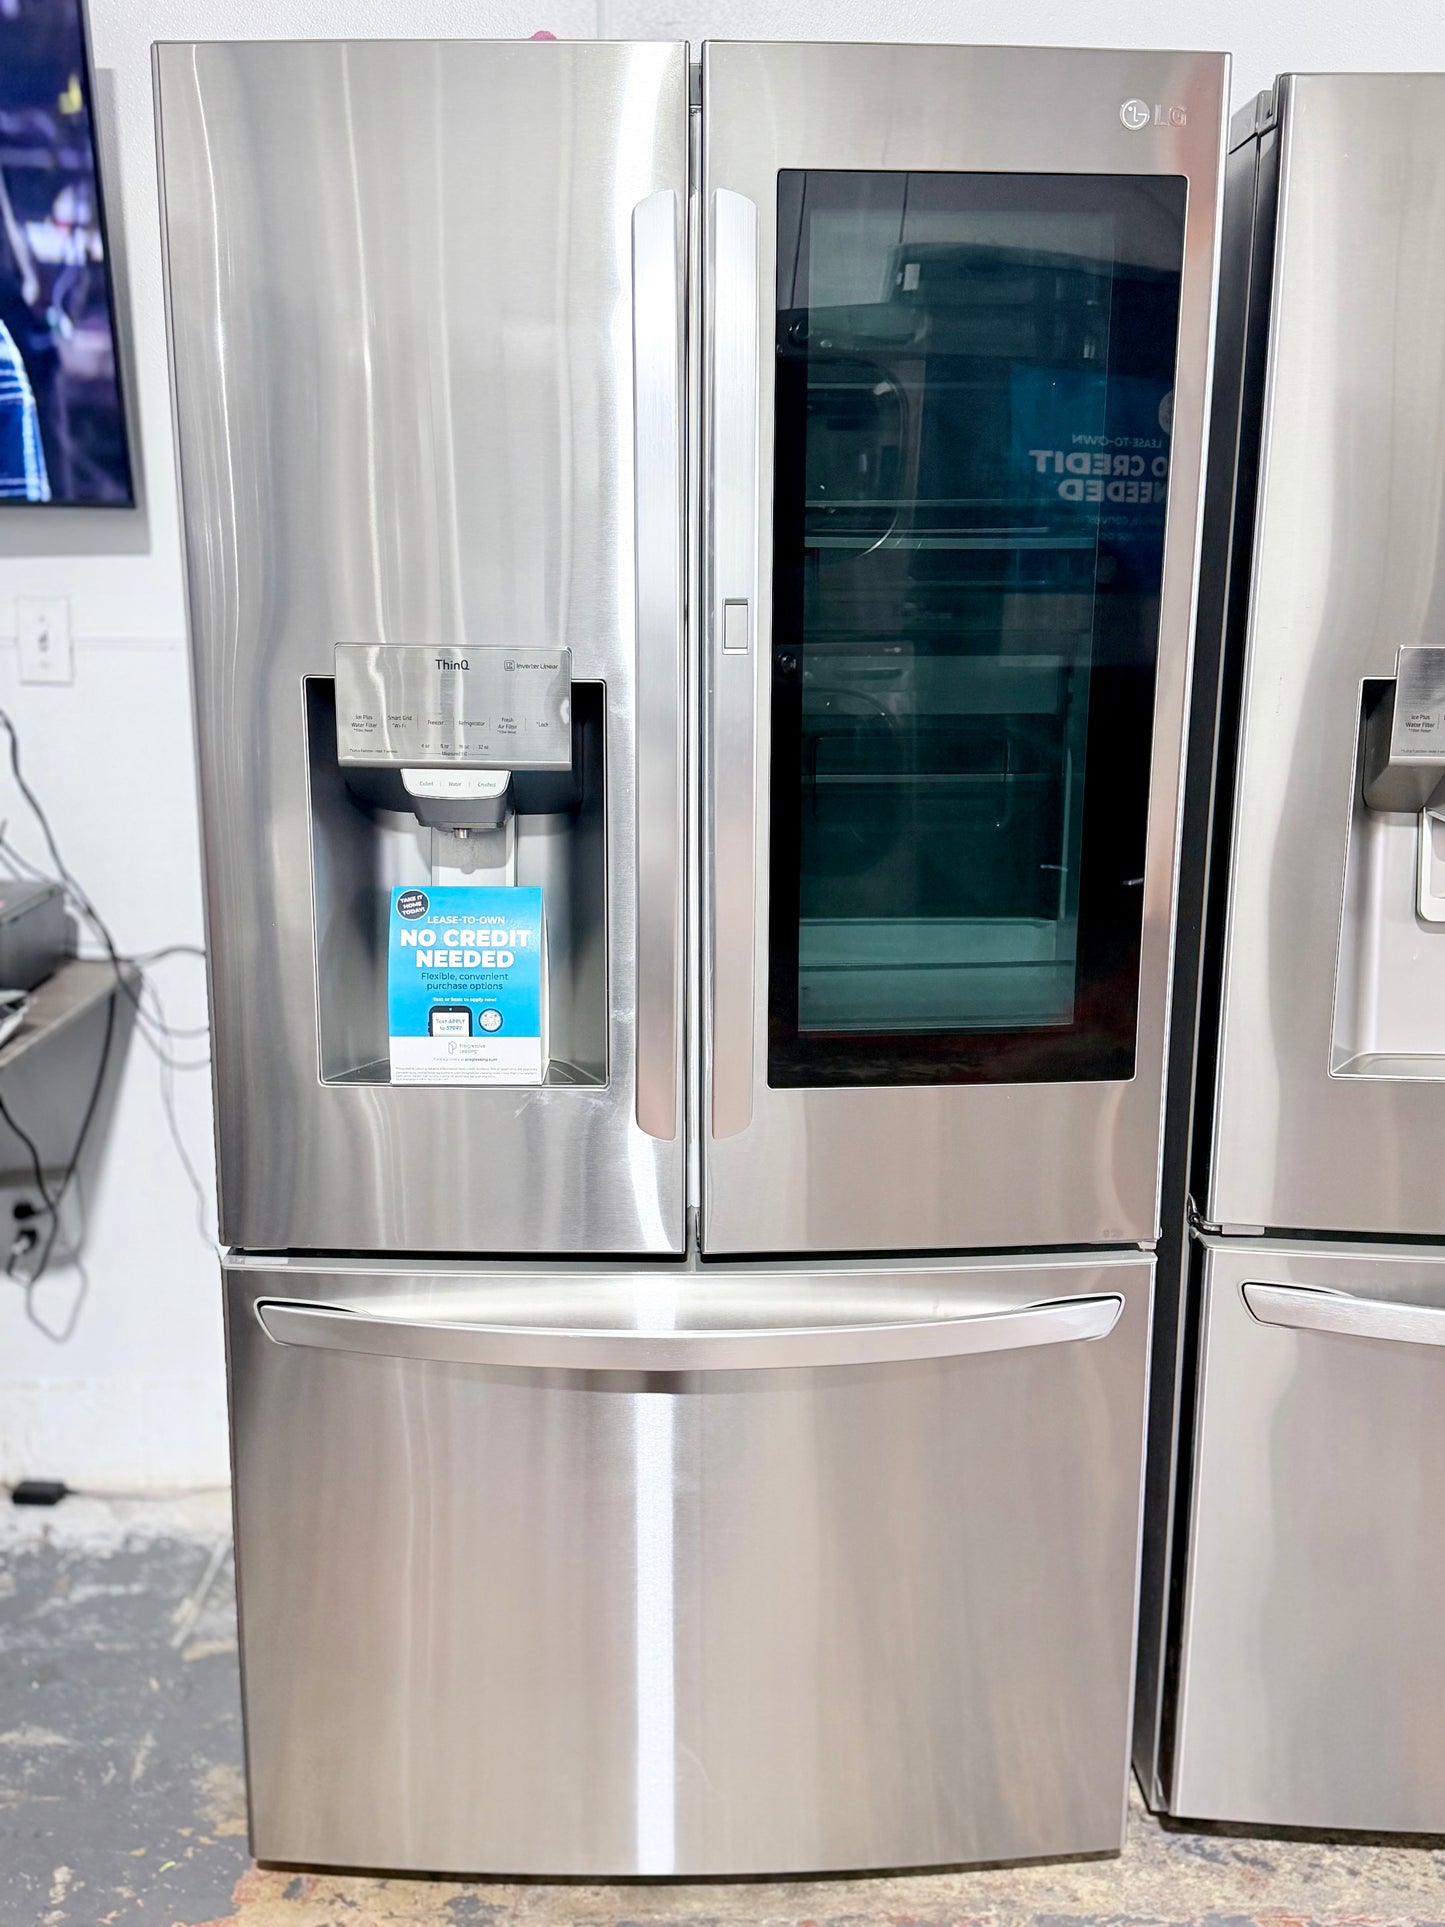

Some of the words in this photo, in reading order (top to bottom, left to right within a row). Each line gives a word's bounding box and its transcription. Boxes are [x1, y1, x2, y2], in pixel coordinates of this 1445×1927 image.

[1153, 103, 1187, 128] LG
[435, 659, 470, 670] ThinQ
[403, 901, 422, 909] HOME
[427, 915, 506, 925] LEASE-TO-OWN
[400, 928, 437, 947] NO
[442, 929, 532, 948] CREDIT
[415, 949, 515, 969] NEEDED
[421, 971, 458, 982] Flexible,
[459, 972, 509, 981] convenient
[426, 982, 468, 992] purchase
[469, 981, 504, 991] options
